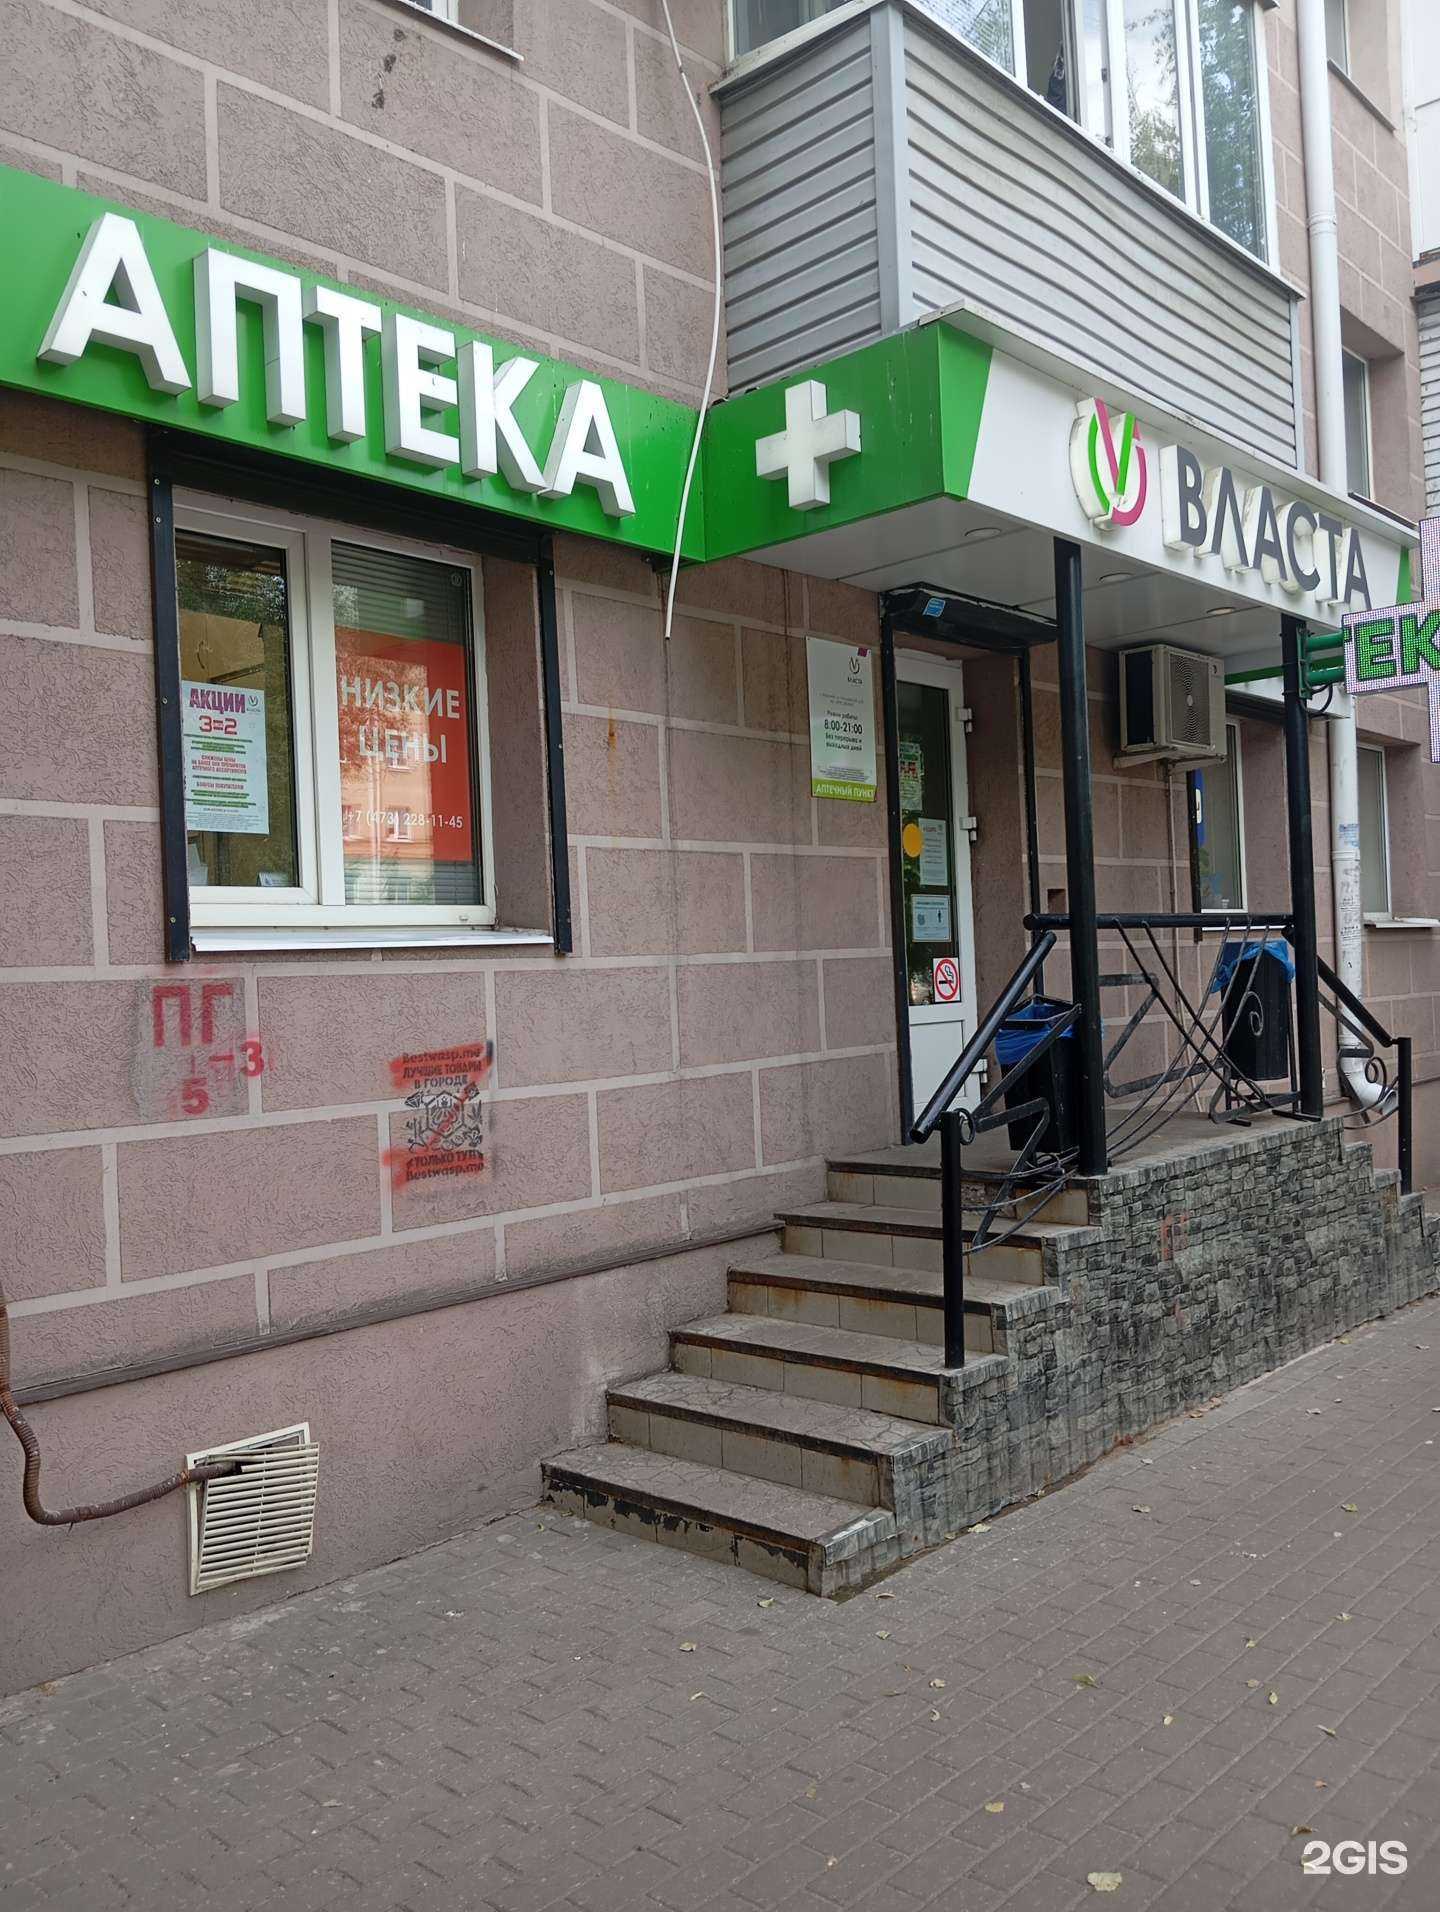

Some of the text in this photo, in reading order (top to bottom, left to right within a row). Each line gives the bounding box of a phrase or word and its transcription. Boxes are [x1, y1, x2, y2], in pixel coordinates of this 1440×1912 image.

[37, 211, 636, 518] АПТЕКА
[1160, 444, 1371, 612] ВЛАСТА
[1343, 609, 1440, 682] ЕК
[190, 688, 246, 714] АКЦИИ
[340, 674, 460, 719] НИЗКИЕ
[199, 715, 237, 735] 3=2
[359, 725, 447, 764] ЦЕНЫ
[816, 783, 874, 798] АПТЕЧНЫЙ ПУНКТ
[404, 812, 463, 828] 228-11-45
[153, 983, 234, 1047] ПГ
[181, 1077, 210, 1115] 5
[424, 1074, 468, 1089] ГОРОДЕ
